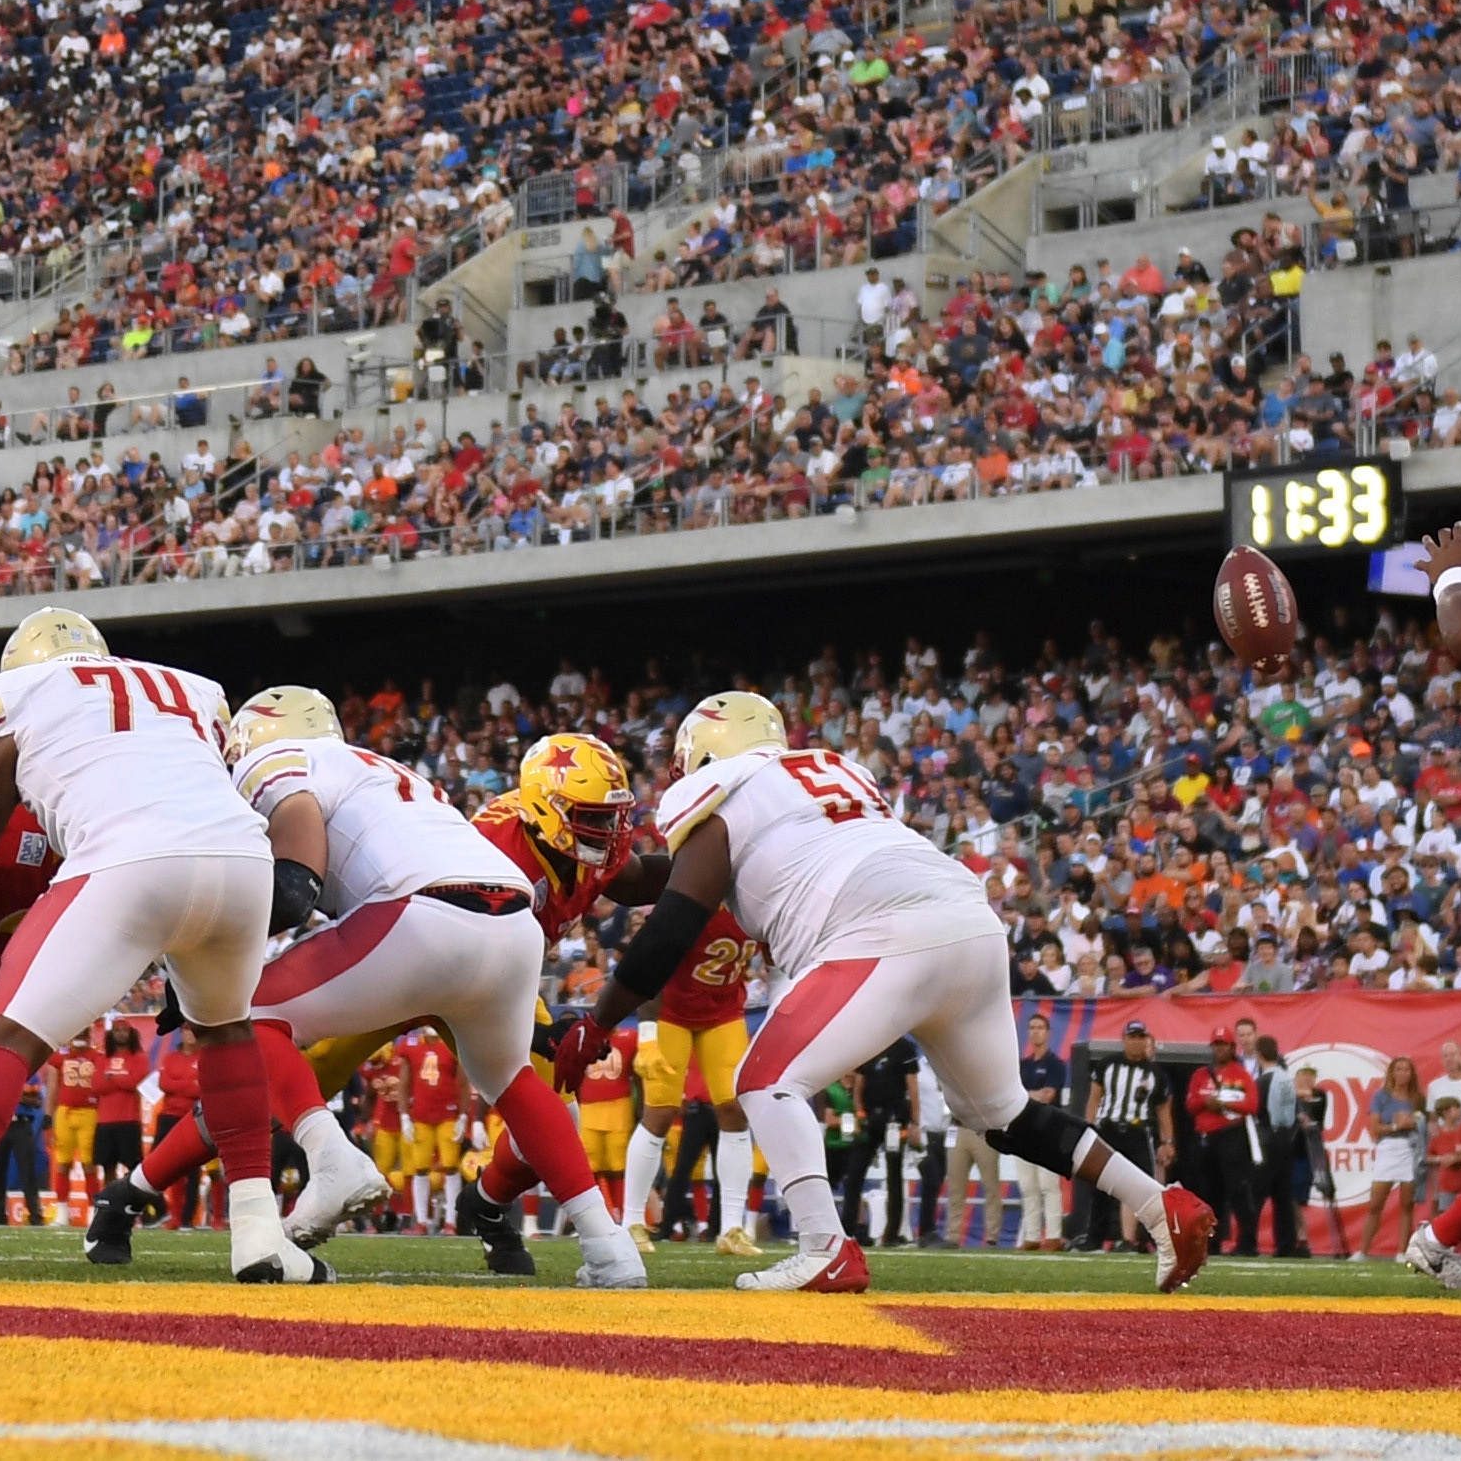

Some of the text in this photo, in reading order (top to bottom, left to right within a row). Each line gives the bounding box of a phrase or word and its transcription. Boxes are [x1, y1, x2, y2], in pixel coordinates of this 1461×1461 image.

[1251, 465, 1388, 547] 11:33
[68, 665, 210, 744] 74
[420, 1051, 440, 1086] 4
